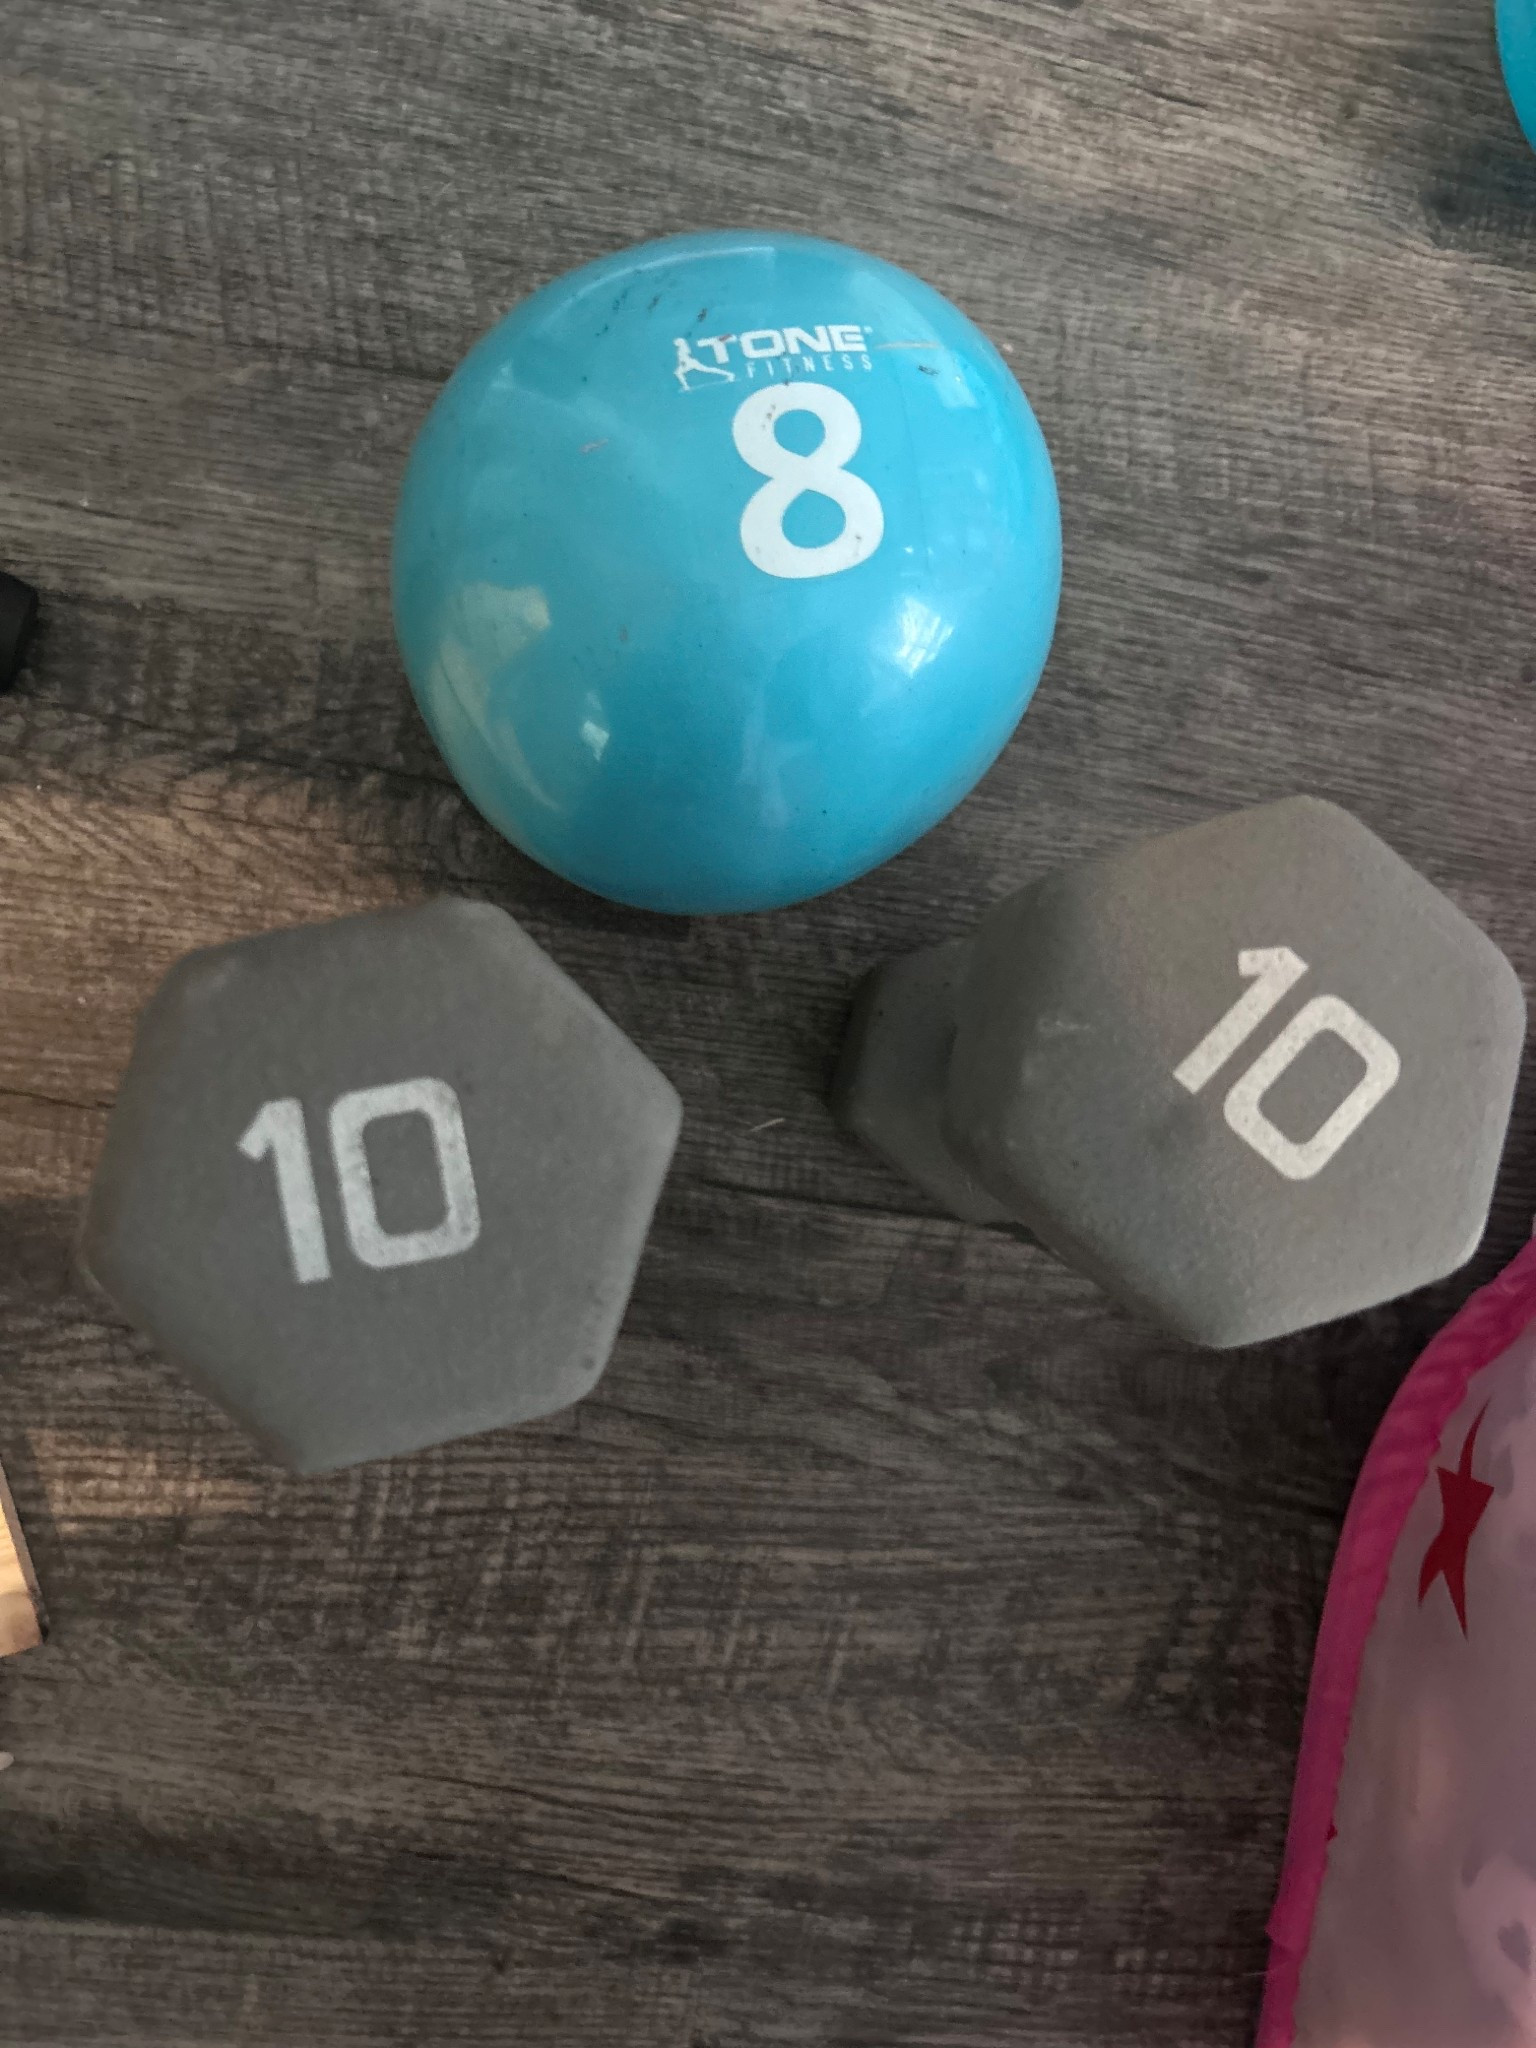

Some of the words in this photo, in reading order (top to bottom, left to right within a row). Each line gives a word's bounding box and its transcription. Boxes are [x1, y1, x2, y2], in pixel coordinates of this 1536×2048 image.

[697, 324, 868, 364] TONE
[745, 353, 873, 379] FITNESS
[732, 381, 885, 579] 8
[1172, 946, 1401, 1180] 10
[236, 1076, 482, 1284] 10
